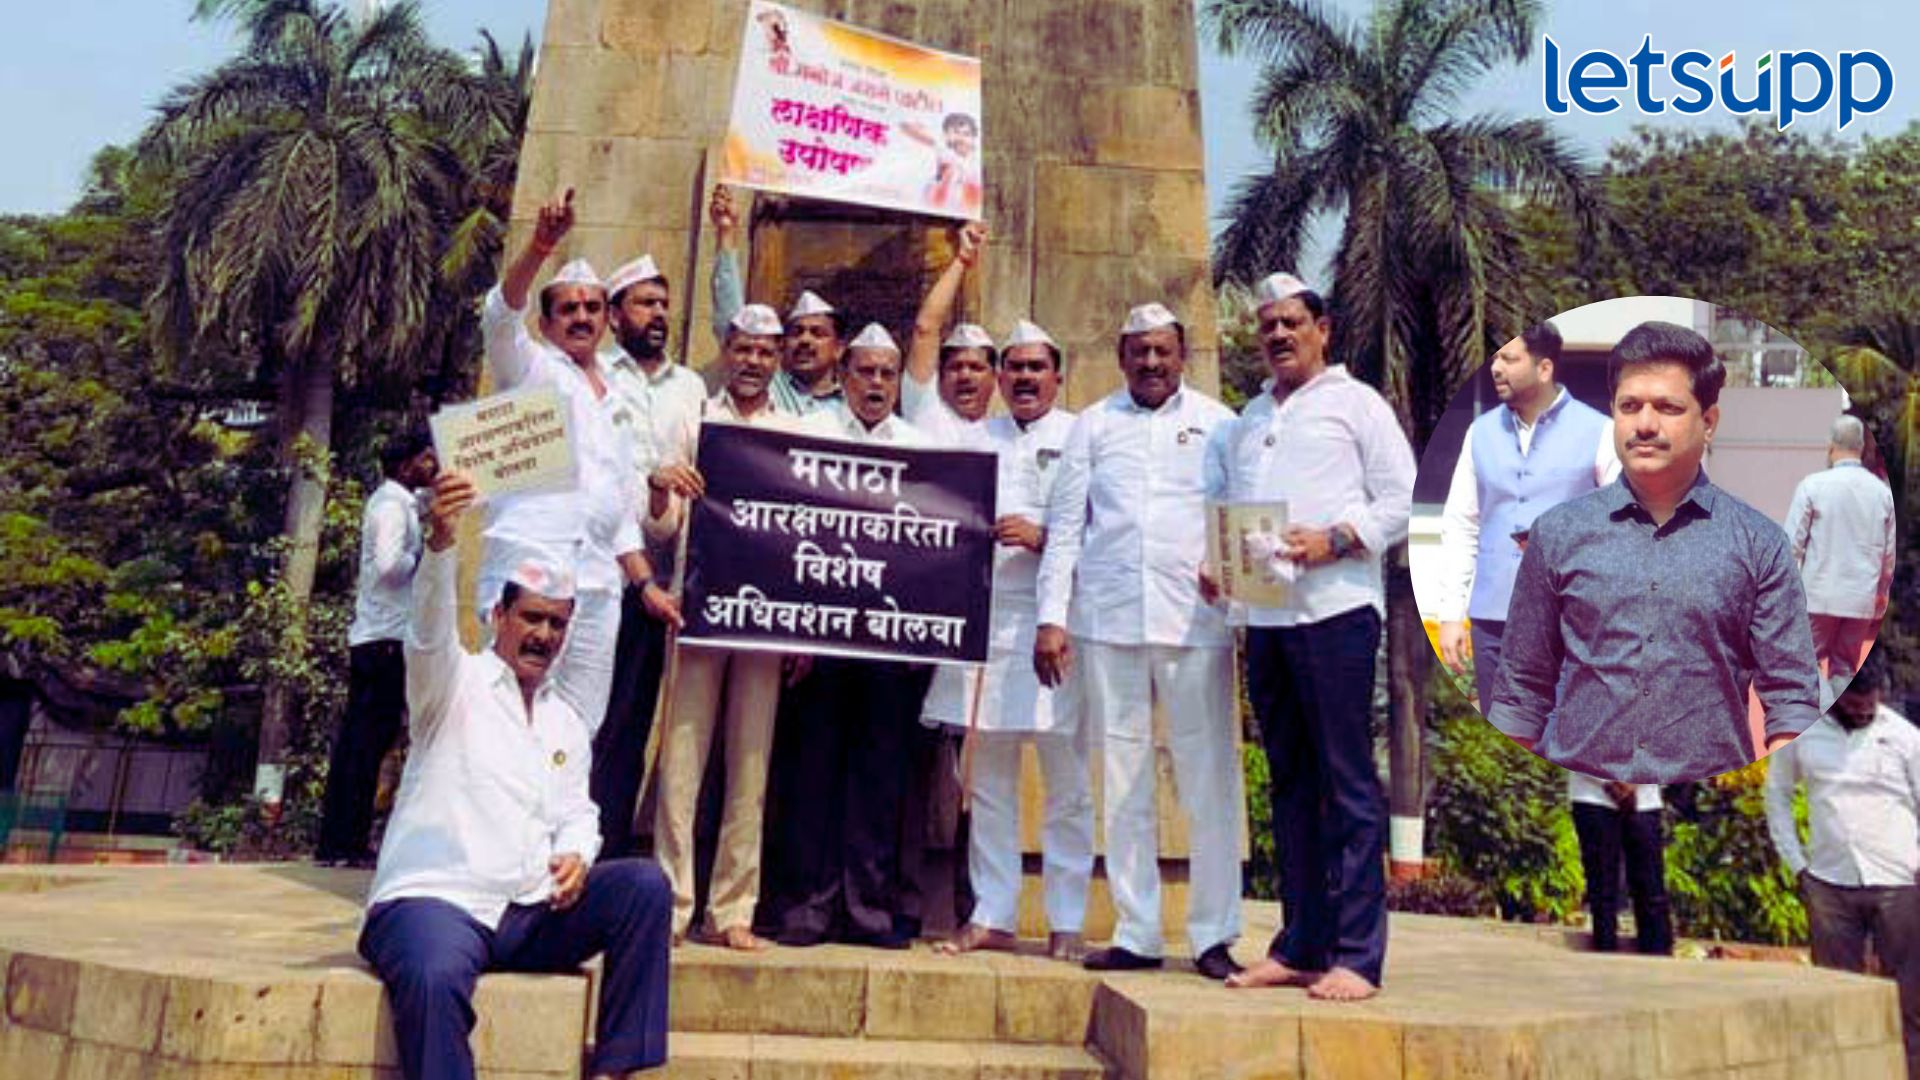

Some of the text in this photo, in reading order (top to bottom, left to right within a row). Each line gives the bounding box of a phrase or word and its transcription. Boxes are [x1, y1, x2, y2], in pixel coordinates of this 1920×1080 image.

[770, 98, 889, 145] लाक्षणिक
[788, 449, 907, 495] मराठा
[730, 499, 959, 548] आरक्षणाकरिता
[792, 540, 887, 589] विशेष
[865, 597, 967, 647] बोलवा
